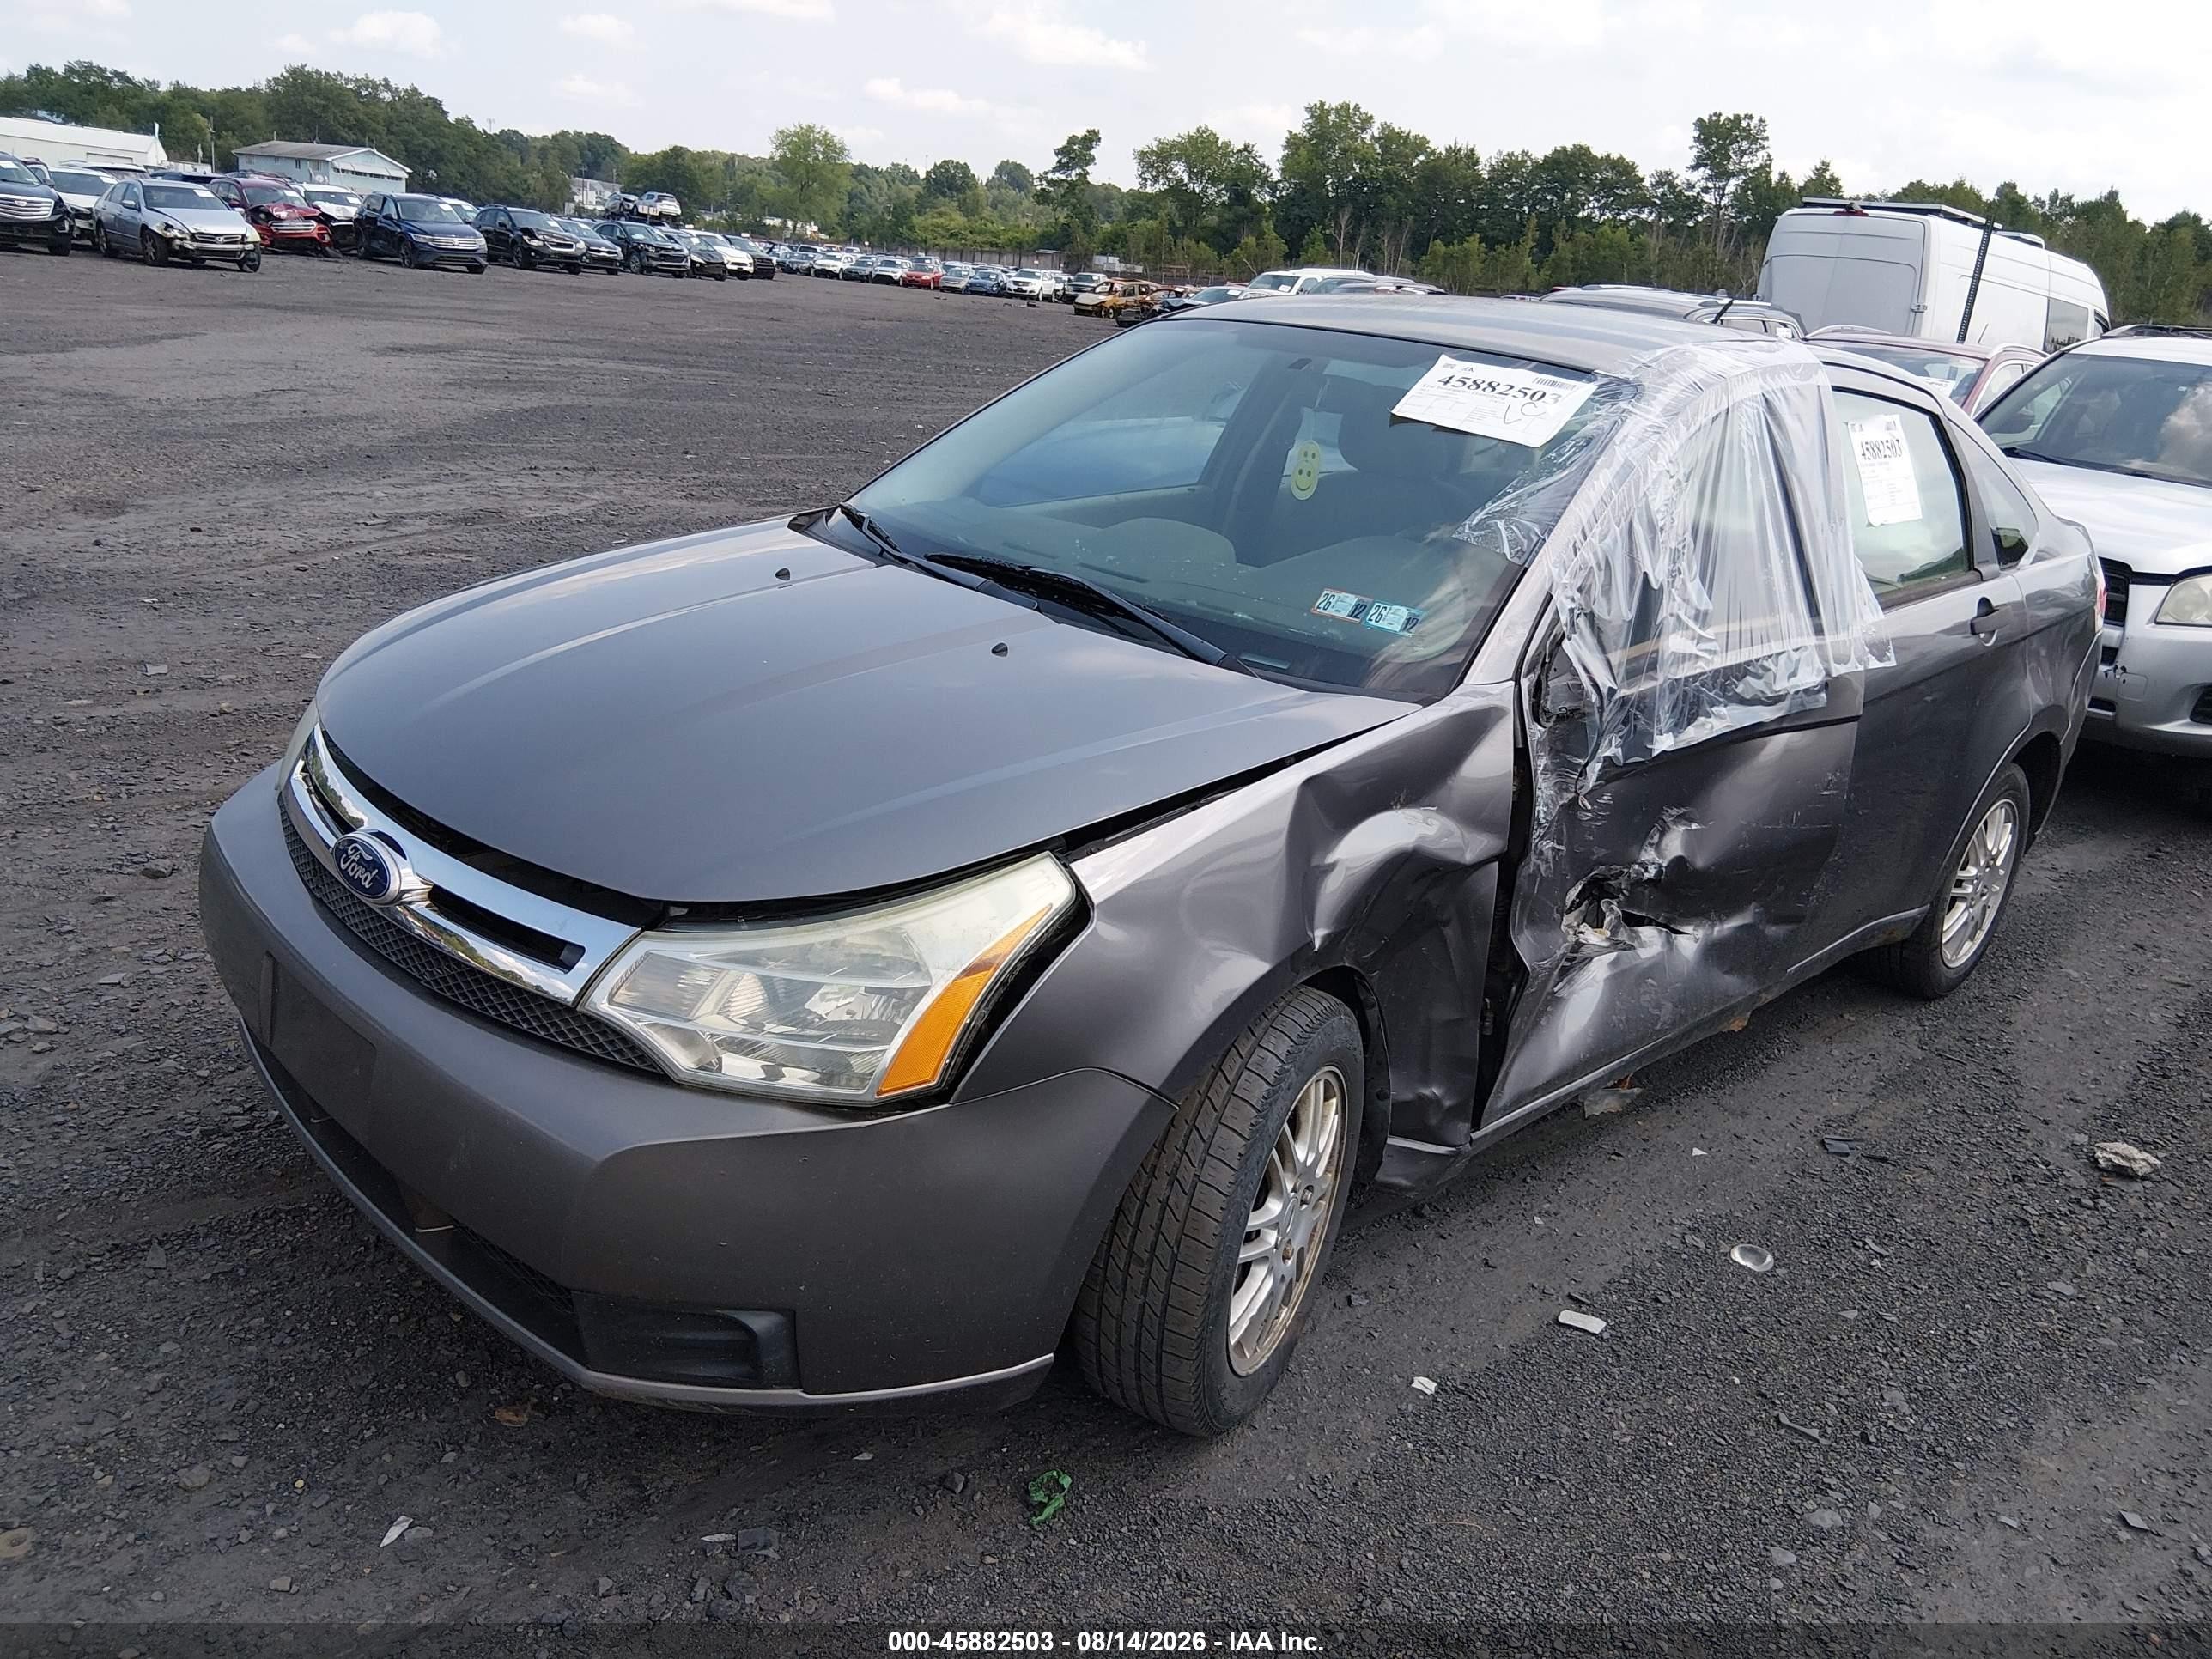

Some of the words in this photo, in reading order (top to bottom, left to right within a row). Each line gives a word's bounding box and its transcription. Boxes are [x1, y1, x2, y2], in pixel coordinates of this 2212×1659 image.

[1437, 374, 1562, 405] 45882503
[1861, 439, 1903, 460] 45882503
[1316, 592, 1335, 611] 26
[1346, 603, 1367, 619] 12
[1368, 605, 1387, 623] 26
[1401, 617, 1419, 634] 12
[340, 842, 378, 889] Ford
